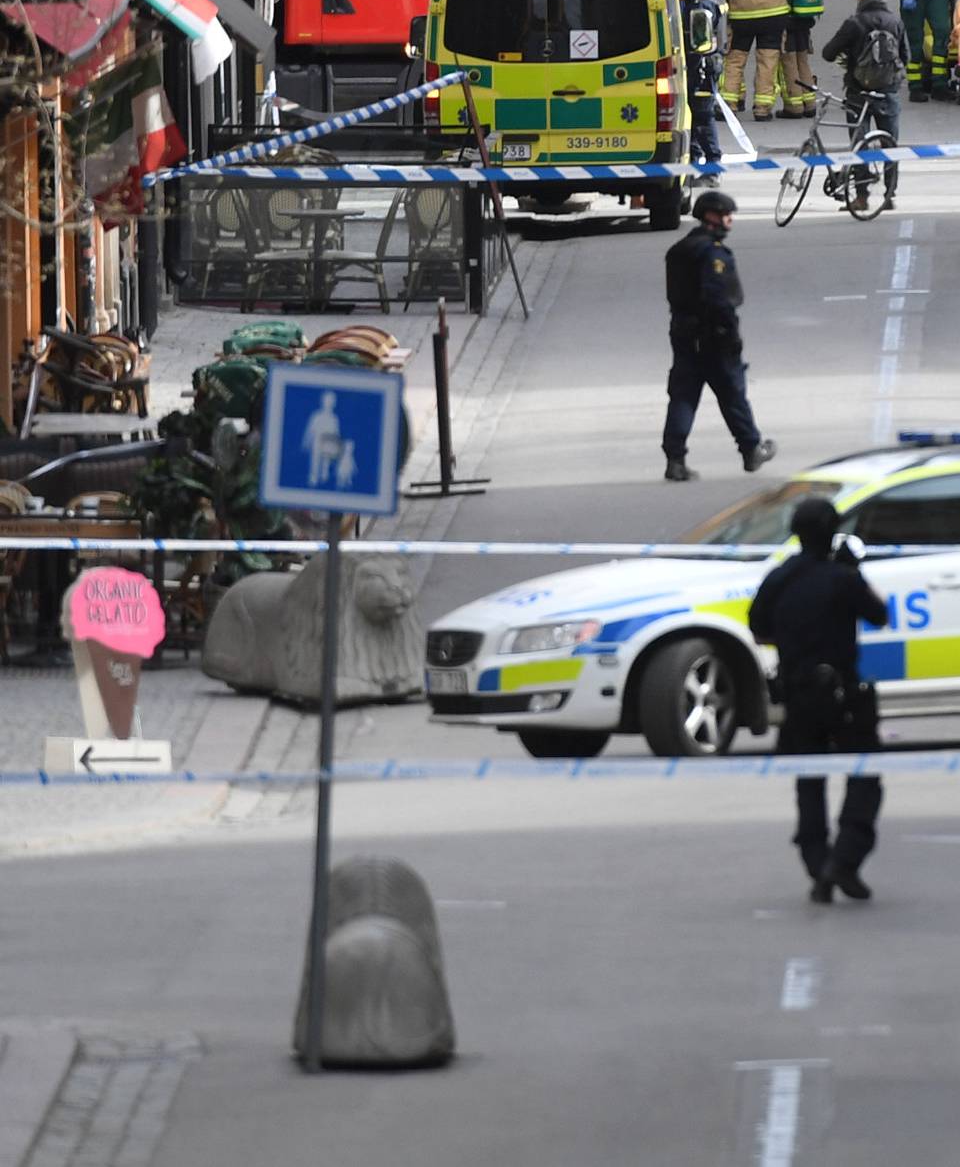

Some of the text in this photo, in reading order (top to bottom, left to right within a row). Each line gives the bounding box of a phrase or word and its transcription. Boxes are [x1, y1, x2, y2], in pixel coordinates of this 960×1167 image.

[566, 136, 628, 149] 339-9180
[85, 579, 145, 601] ORGANIC
[87, 602, 147, 625] GELATO
